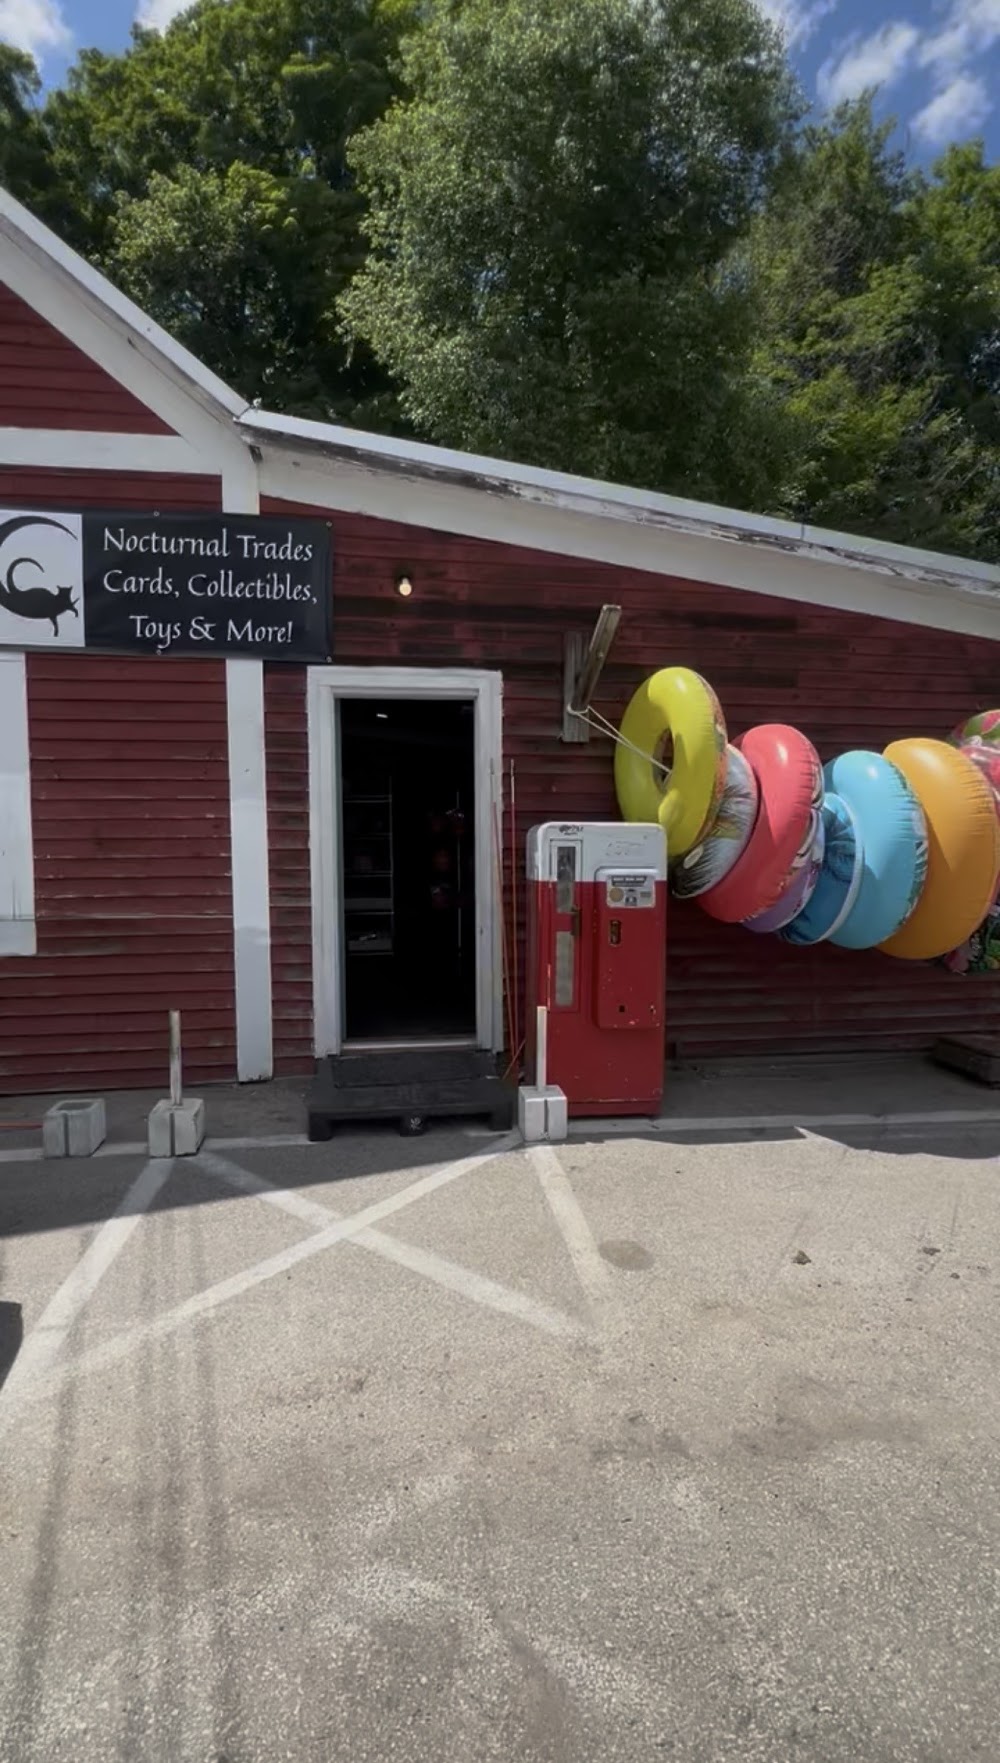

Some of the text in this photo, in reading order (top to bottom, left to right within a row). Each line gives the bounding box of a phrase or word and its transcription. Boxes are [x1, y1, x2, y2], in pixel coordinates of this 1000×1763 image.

[103, 527, 313, 561] Nocturnal Trades
[103, 566, 318, 604] Cards, Collectibles,
[129, 615, 293, 649] Toys & More!
